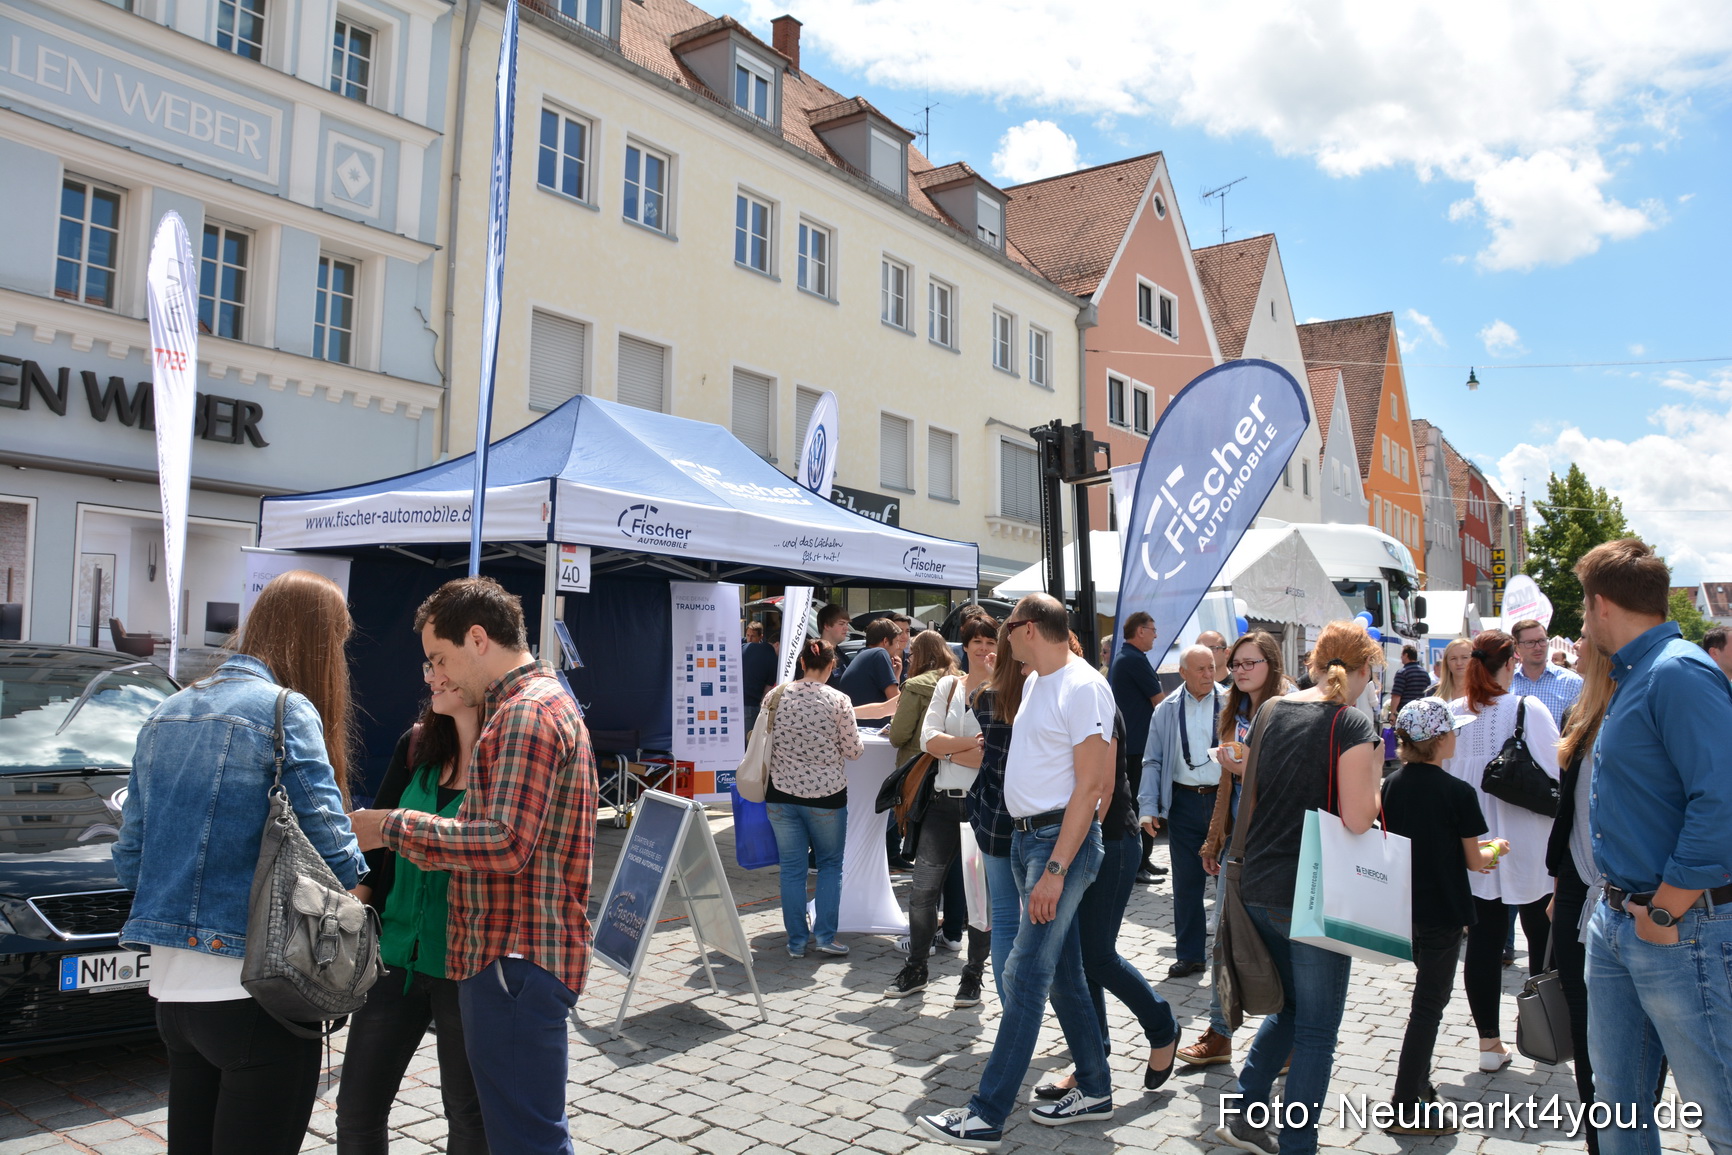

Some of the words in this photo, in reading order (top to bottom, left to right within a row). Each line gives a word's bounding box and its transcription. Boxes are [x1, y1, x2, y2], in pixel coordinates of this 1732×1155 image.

[113, 72, 263, 160] WEBER
[1164, 393, 1266, 555] Fischer
[1197, 422, 1278, 553] AUTOMOBILE
[305, 504, 472, 530] www.fischer-automobile.d
[631, 518, 692, 540] Fischer
[637, 537, 688, 550] AUTOMOBILE
[782, 536, 797, 549] und
[799, 535, 814, 548] das
[561, 565, 581, 584] 40
[910, 557, 947, 573] Fischer
[914, 571, 944, 580] AUTOMOBILE
[675, 602, 716, 611] TRAUMJOB
[1361, 866, 1388, 882] ENERCON
[1308, 862, 1319, 911] www.enercon.de
[81, 956, 117, 985] NM
[65, 976, 73, 985] D
